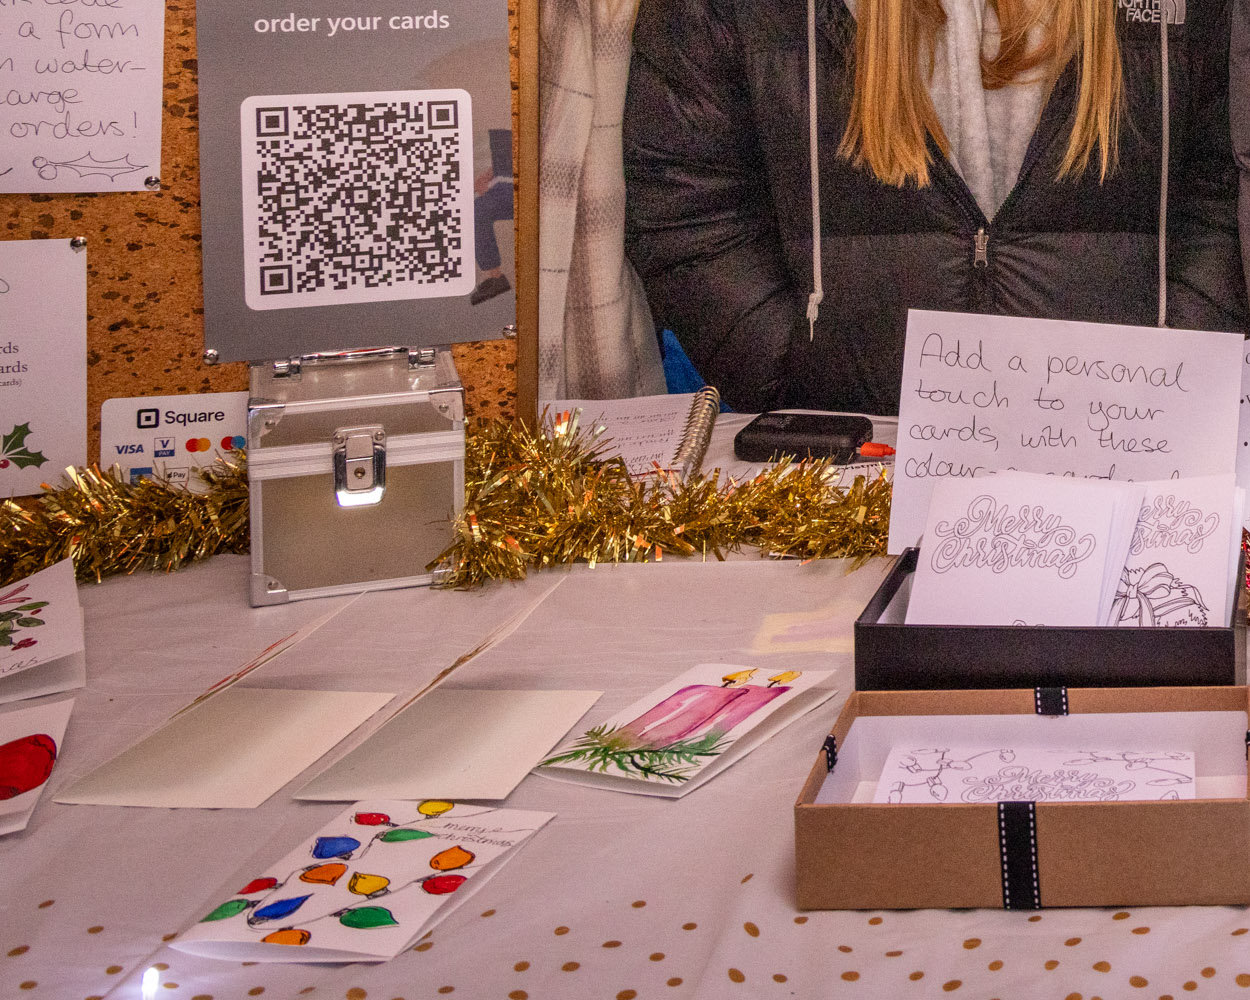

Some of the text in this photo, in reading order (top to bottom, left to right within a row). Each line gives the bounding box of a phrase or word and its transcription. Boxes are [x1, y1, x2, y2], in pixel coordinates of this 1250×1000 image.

[18, 9, 139, 49] a form
[254, 10, 450, 36] order your cards
[1126, 8, 1161, 22] FACE
[0, 88, 83, 113] arge
[10, 110, 137, 139] orders!
[919, 332, 1189, 393] Add a personal
[165, 410, 225, 427] Square
[915, 379, 1165, 432] touch to your
[114, 444, 144, 454] VISA
[909, 415, 1172, 454] cards, with these
[172, 471, 186, 480] Pay
[935, 495, 1202, 547] Merry erry
[931, 534, 1096, 580] Christmas
